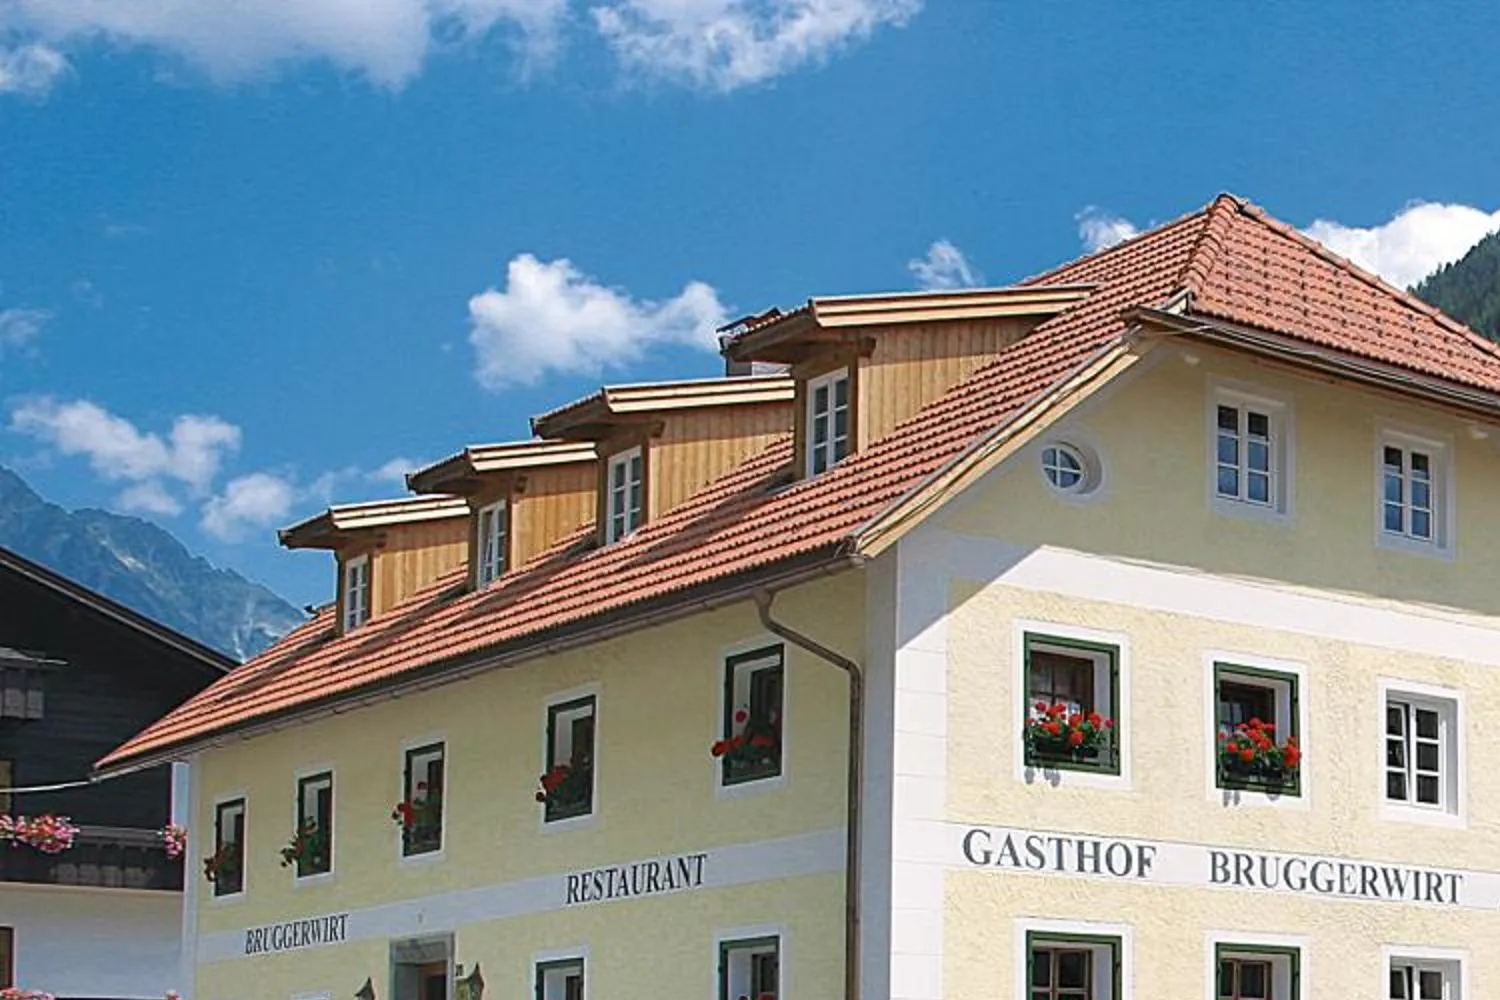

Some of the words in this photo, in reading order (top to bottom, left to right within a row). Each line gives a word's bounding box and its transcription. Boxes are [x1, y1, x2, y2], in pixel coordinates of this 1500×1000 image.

[245, 913, 349, 955] BRUGGERWIRT
[566, 853, 708, 905] RESTAURANT
[963, 828, 1157, 878] GASTHOF
[1208, 850, 1463, 905] BRUGGERWIRT
